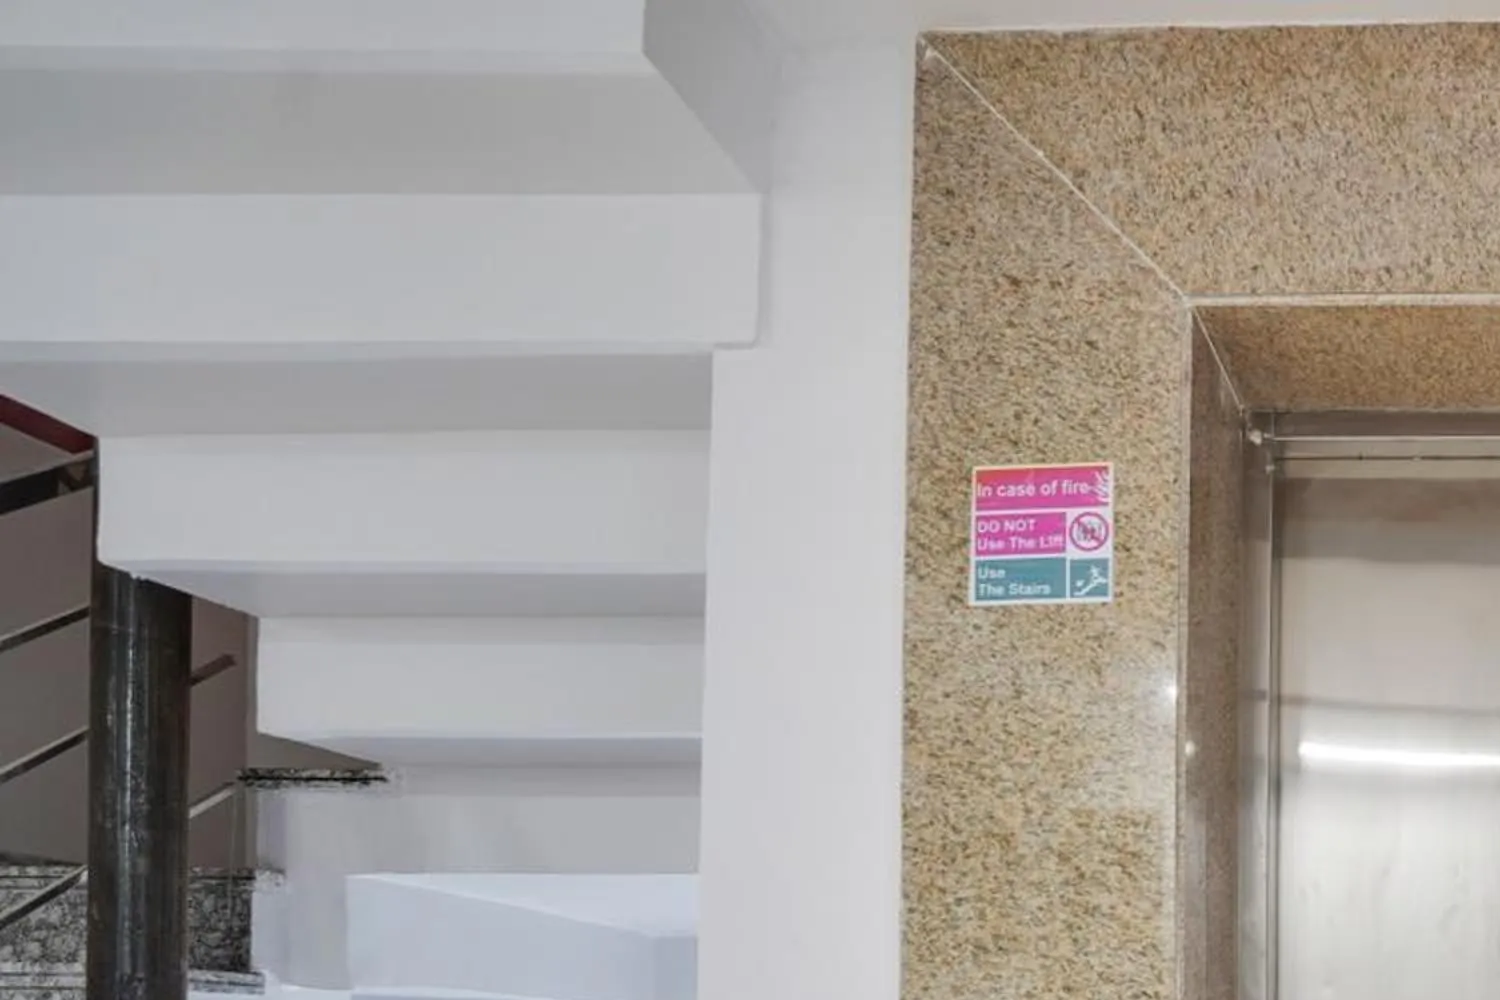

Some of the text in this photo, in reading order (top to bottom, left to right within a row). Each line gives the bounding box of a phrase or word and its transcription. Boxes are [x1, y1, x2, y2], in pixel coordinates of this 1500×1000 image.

[976, 482, 992, 497] In
[996, 483, 1036, 497] case
[1040, 479, 1058, 496] of
[977, 518, 1037, 534] DO NOT
[977, 537, 1006, 551] Use
[1010, 535, 1036, 550] The
[977, 565, 1007, 580] Use
[978, 582, 1051, 597] The Stairs
